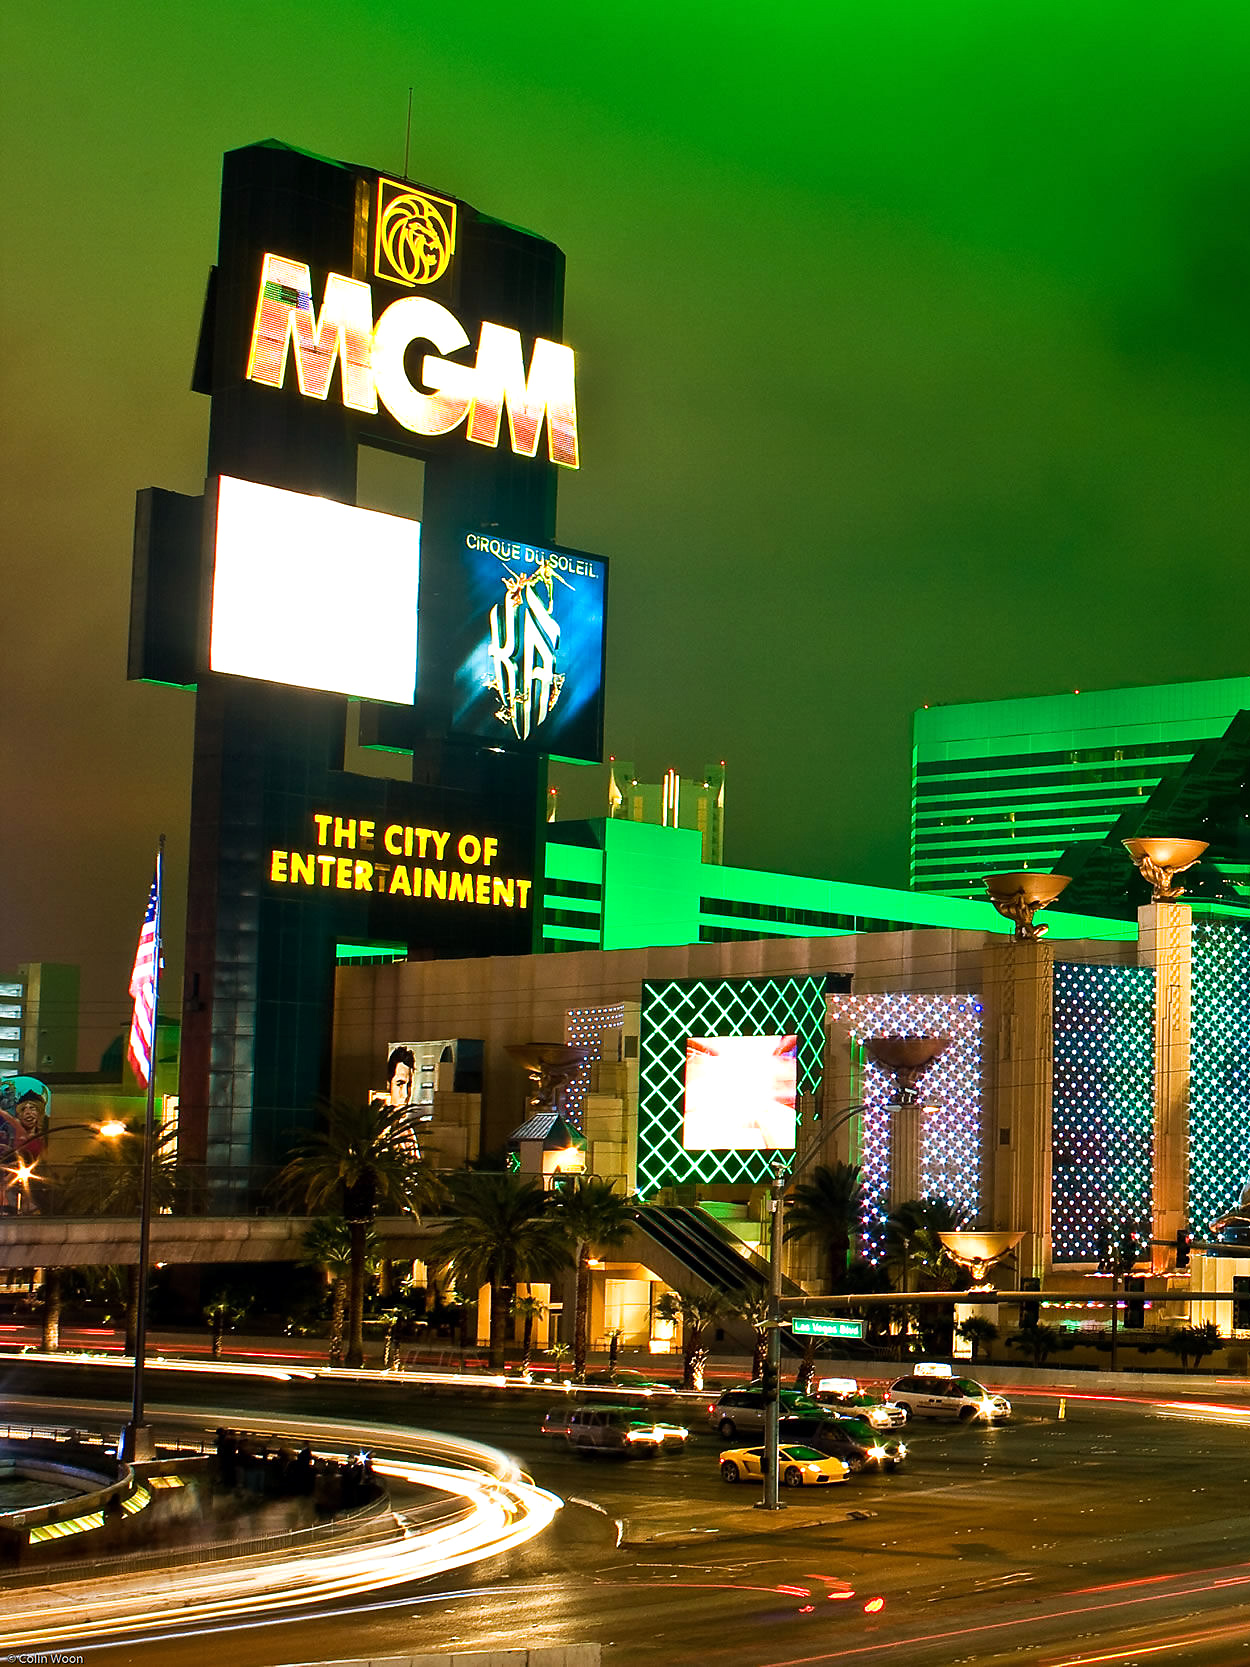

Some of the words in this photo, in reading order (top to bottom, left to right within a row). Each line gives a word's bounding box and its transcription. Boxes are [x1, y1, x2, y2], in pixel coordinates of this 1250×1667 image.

[246, 252, 580, 470] MGM
[314, 814, 375, 851] THE
[384, 824, 450, 861] CITY
[457, 834, 498, 866] OF
[270, 850, 532, 909] ENTERTAINMENT
[795, 1321, 811, 1331] Las
[812, 1322, 838, 1336] Vegas
